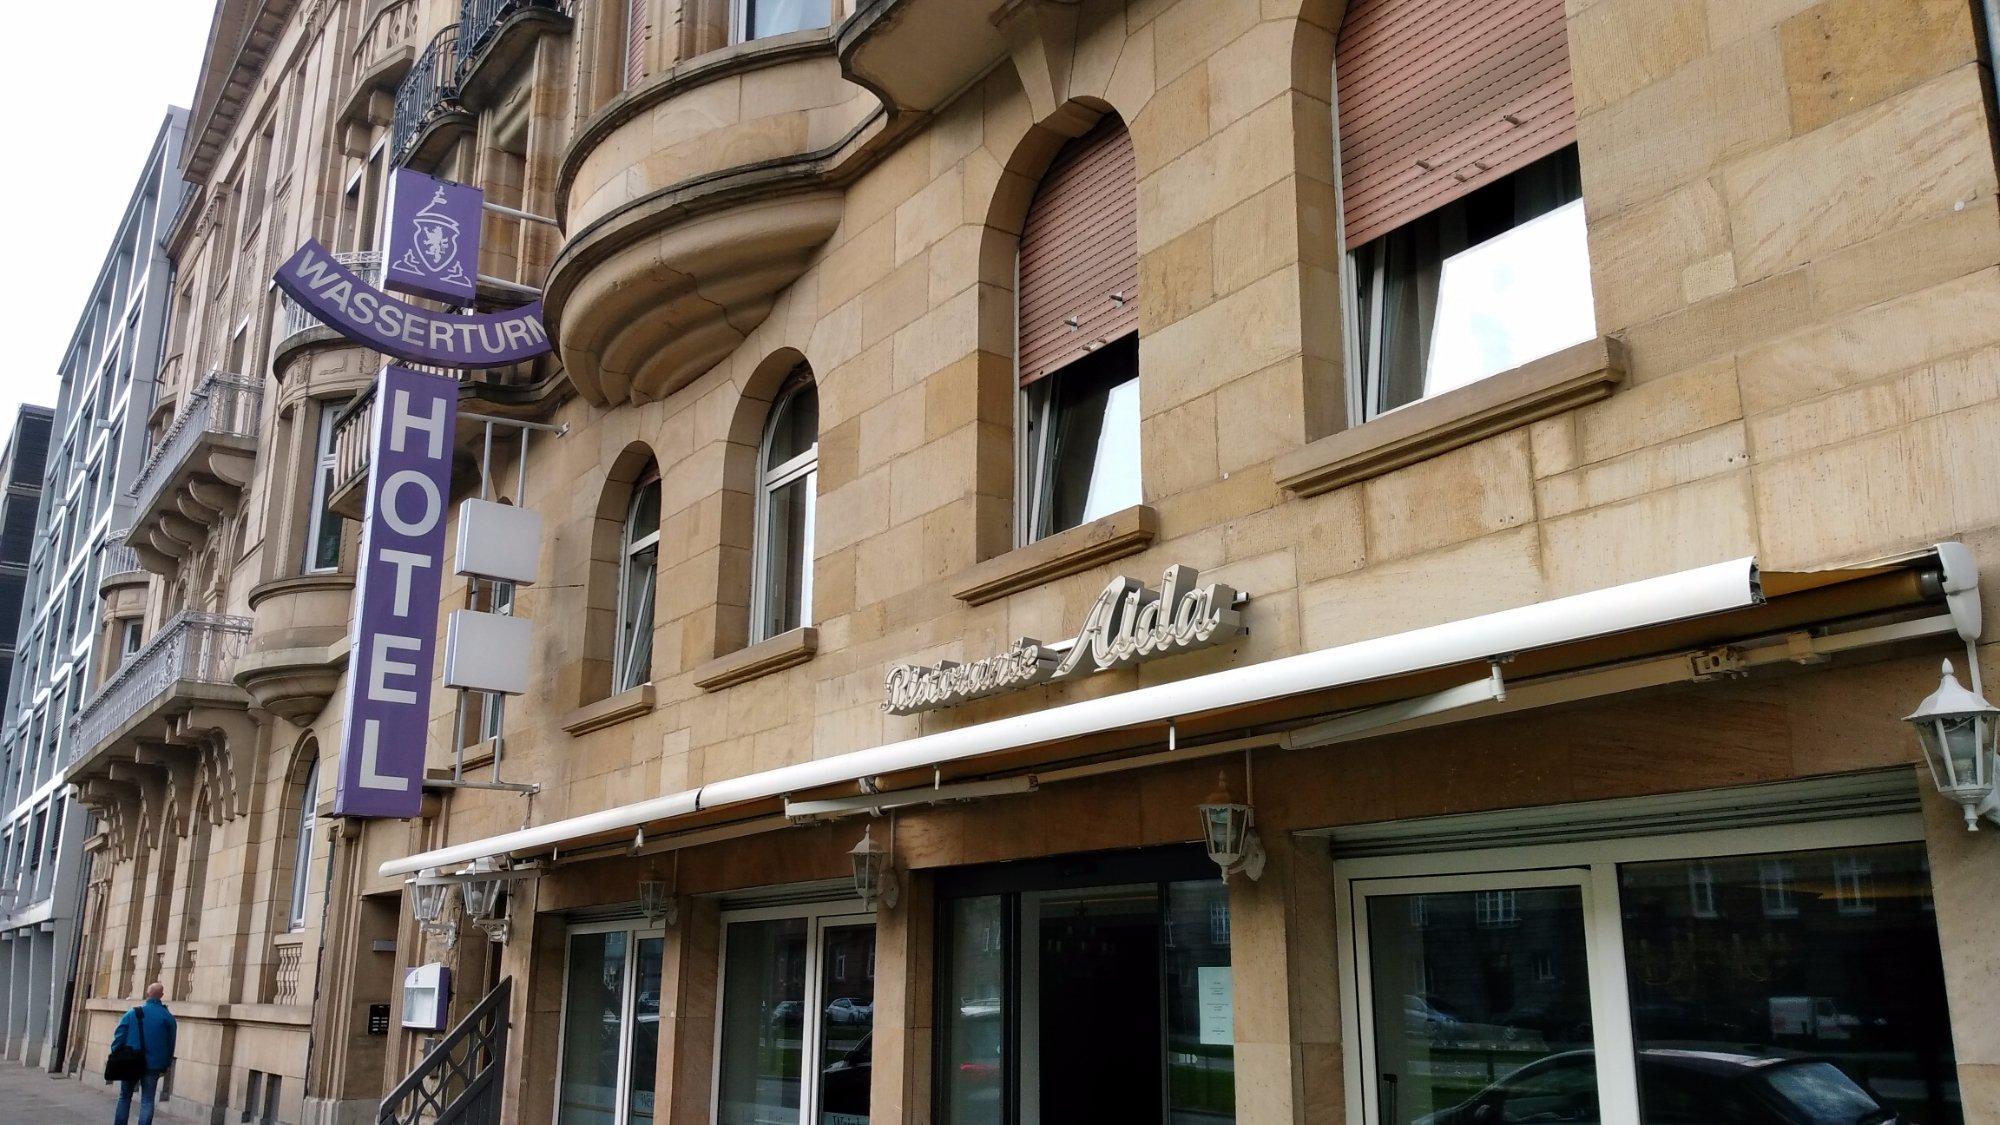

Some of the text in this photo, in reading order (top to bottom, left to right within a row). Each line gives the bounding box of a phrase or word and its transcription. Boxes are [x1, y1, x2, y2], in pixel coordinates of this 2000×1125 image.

[358, 389, 447, 791] HOTEL
[880, 563, 1222, 711] Ristorante Aida
